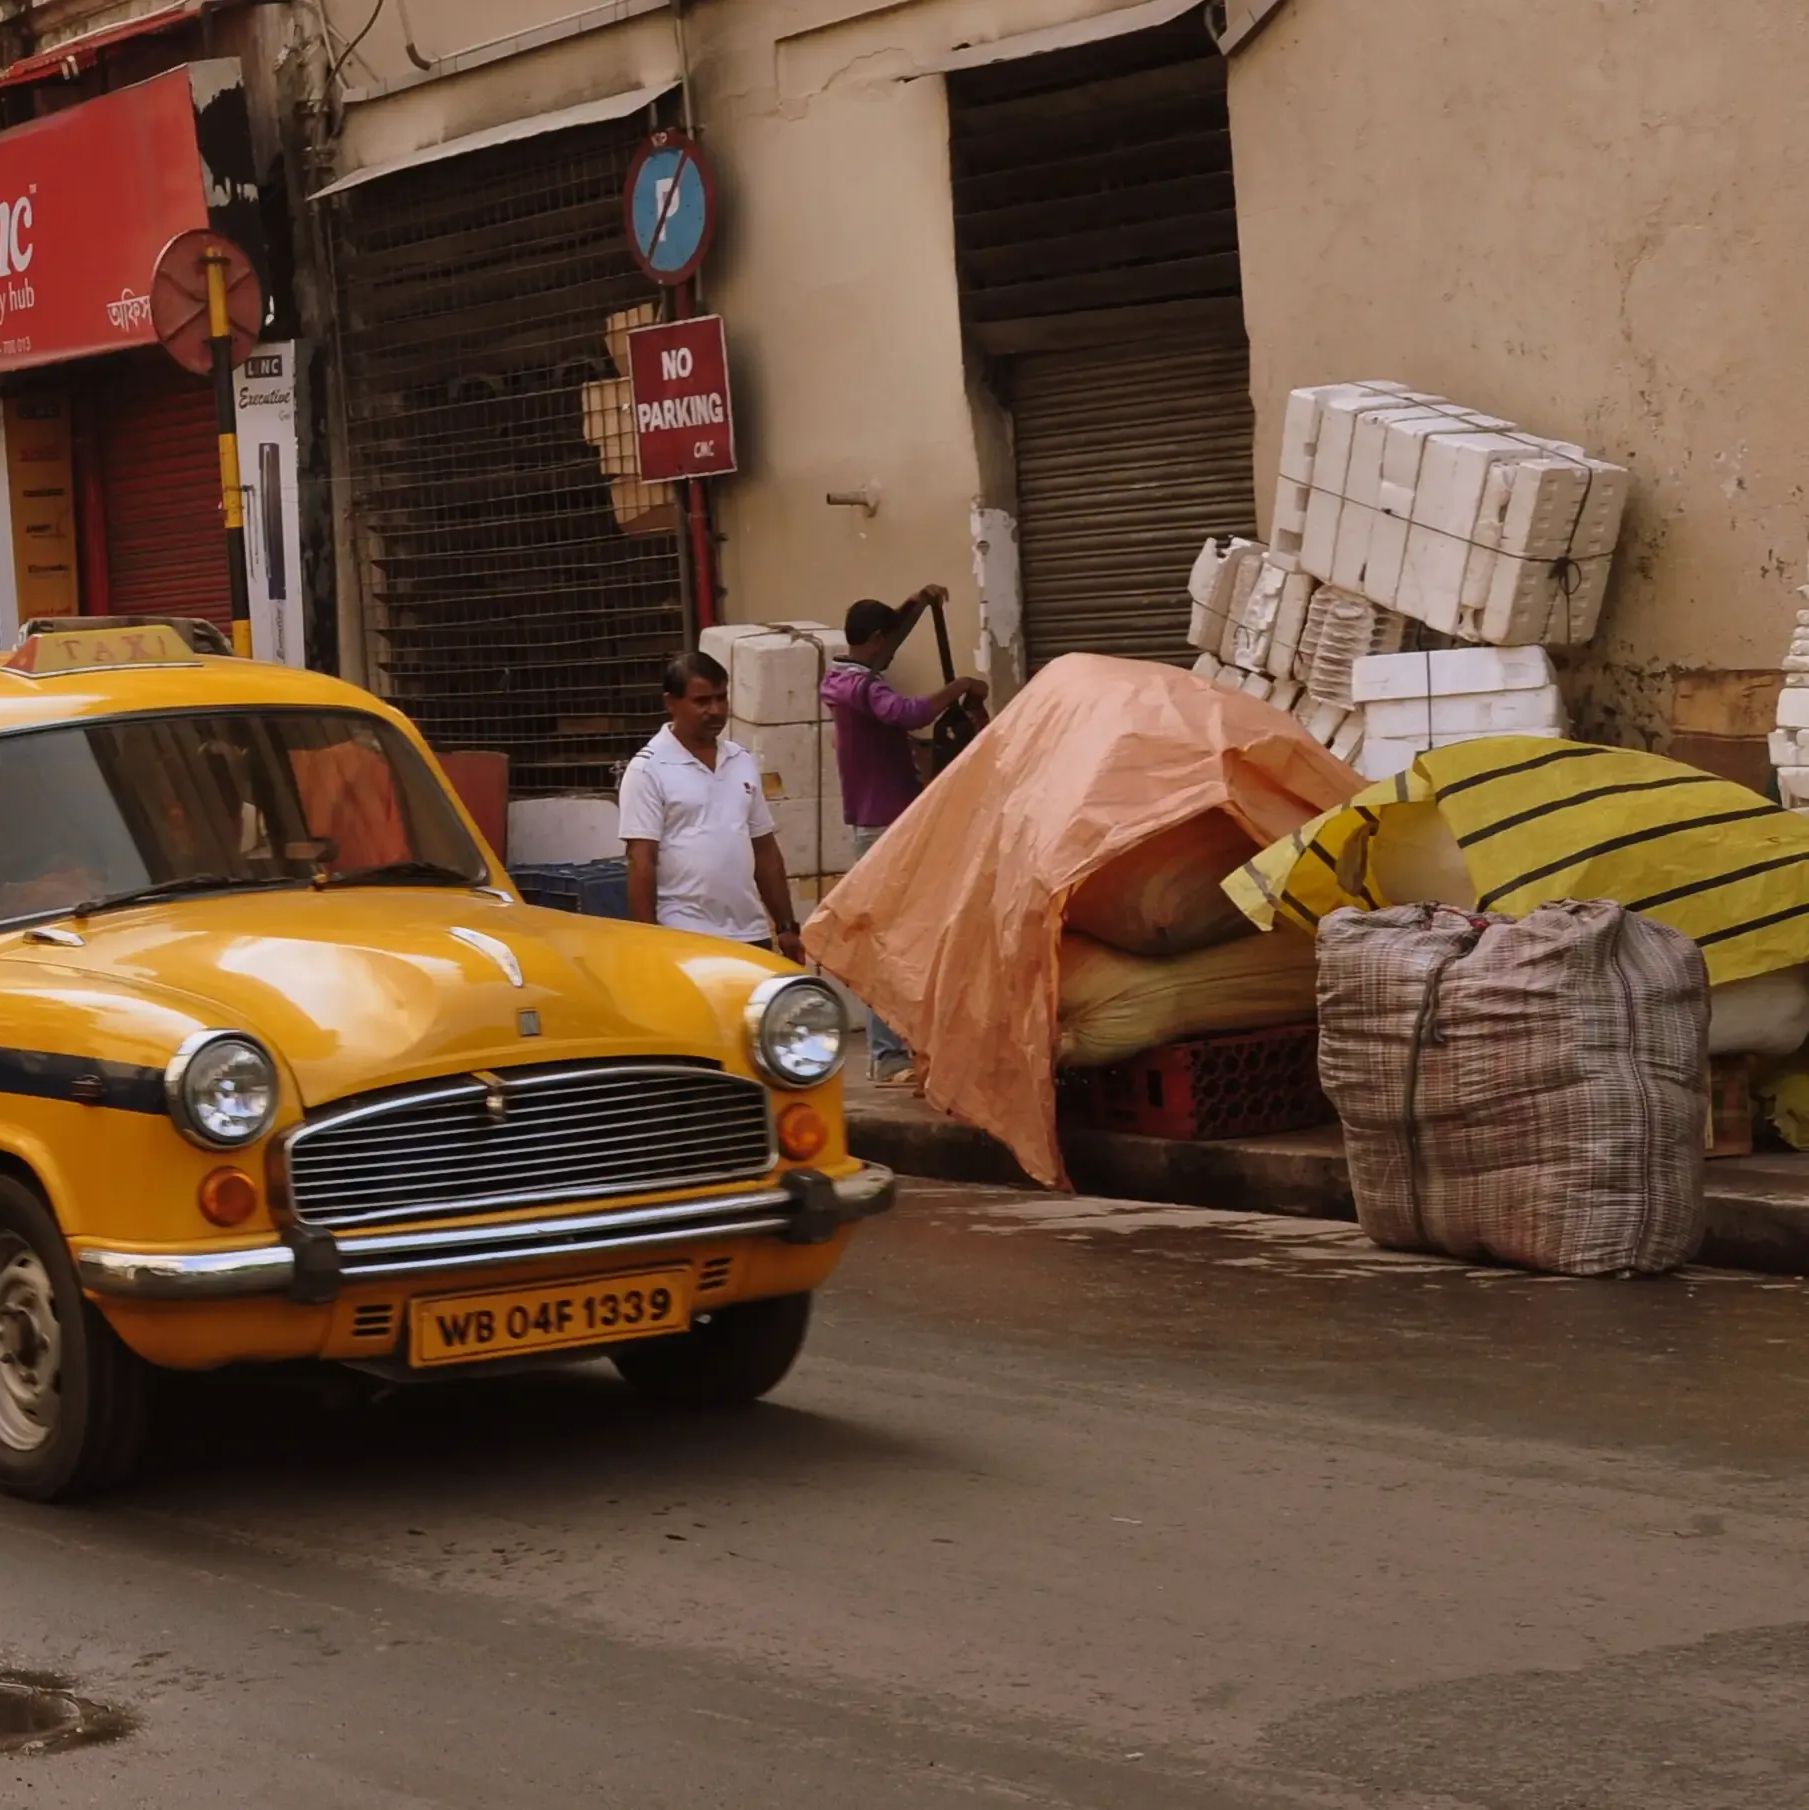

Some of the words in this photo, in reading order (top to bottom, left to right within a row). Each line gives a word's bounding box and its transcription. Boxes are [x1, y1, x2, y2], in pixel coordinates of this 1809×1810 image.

[9, 278, 35, 313] hub
[247, 357, 280, 377] LNC
[661, 347, 693, 381] NO
[238, 386, 291, 409] Executive
[637, 391, 724, 435] PARKING
[55, 632, 167, 663] TAXI
[436, 1309, 495, 1347] WB
[506, 1298, 575, 1340] 04F
[583, 1287, 672, 1329] 1339
